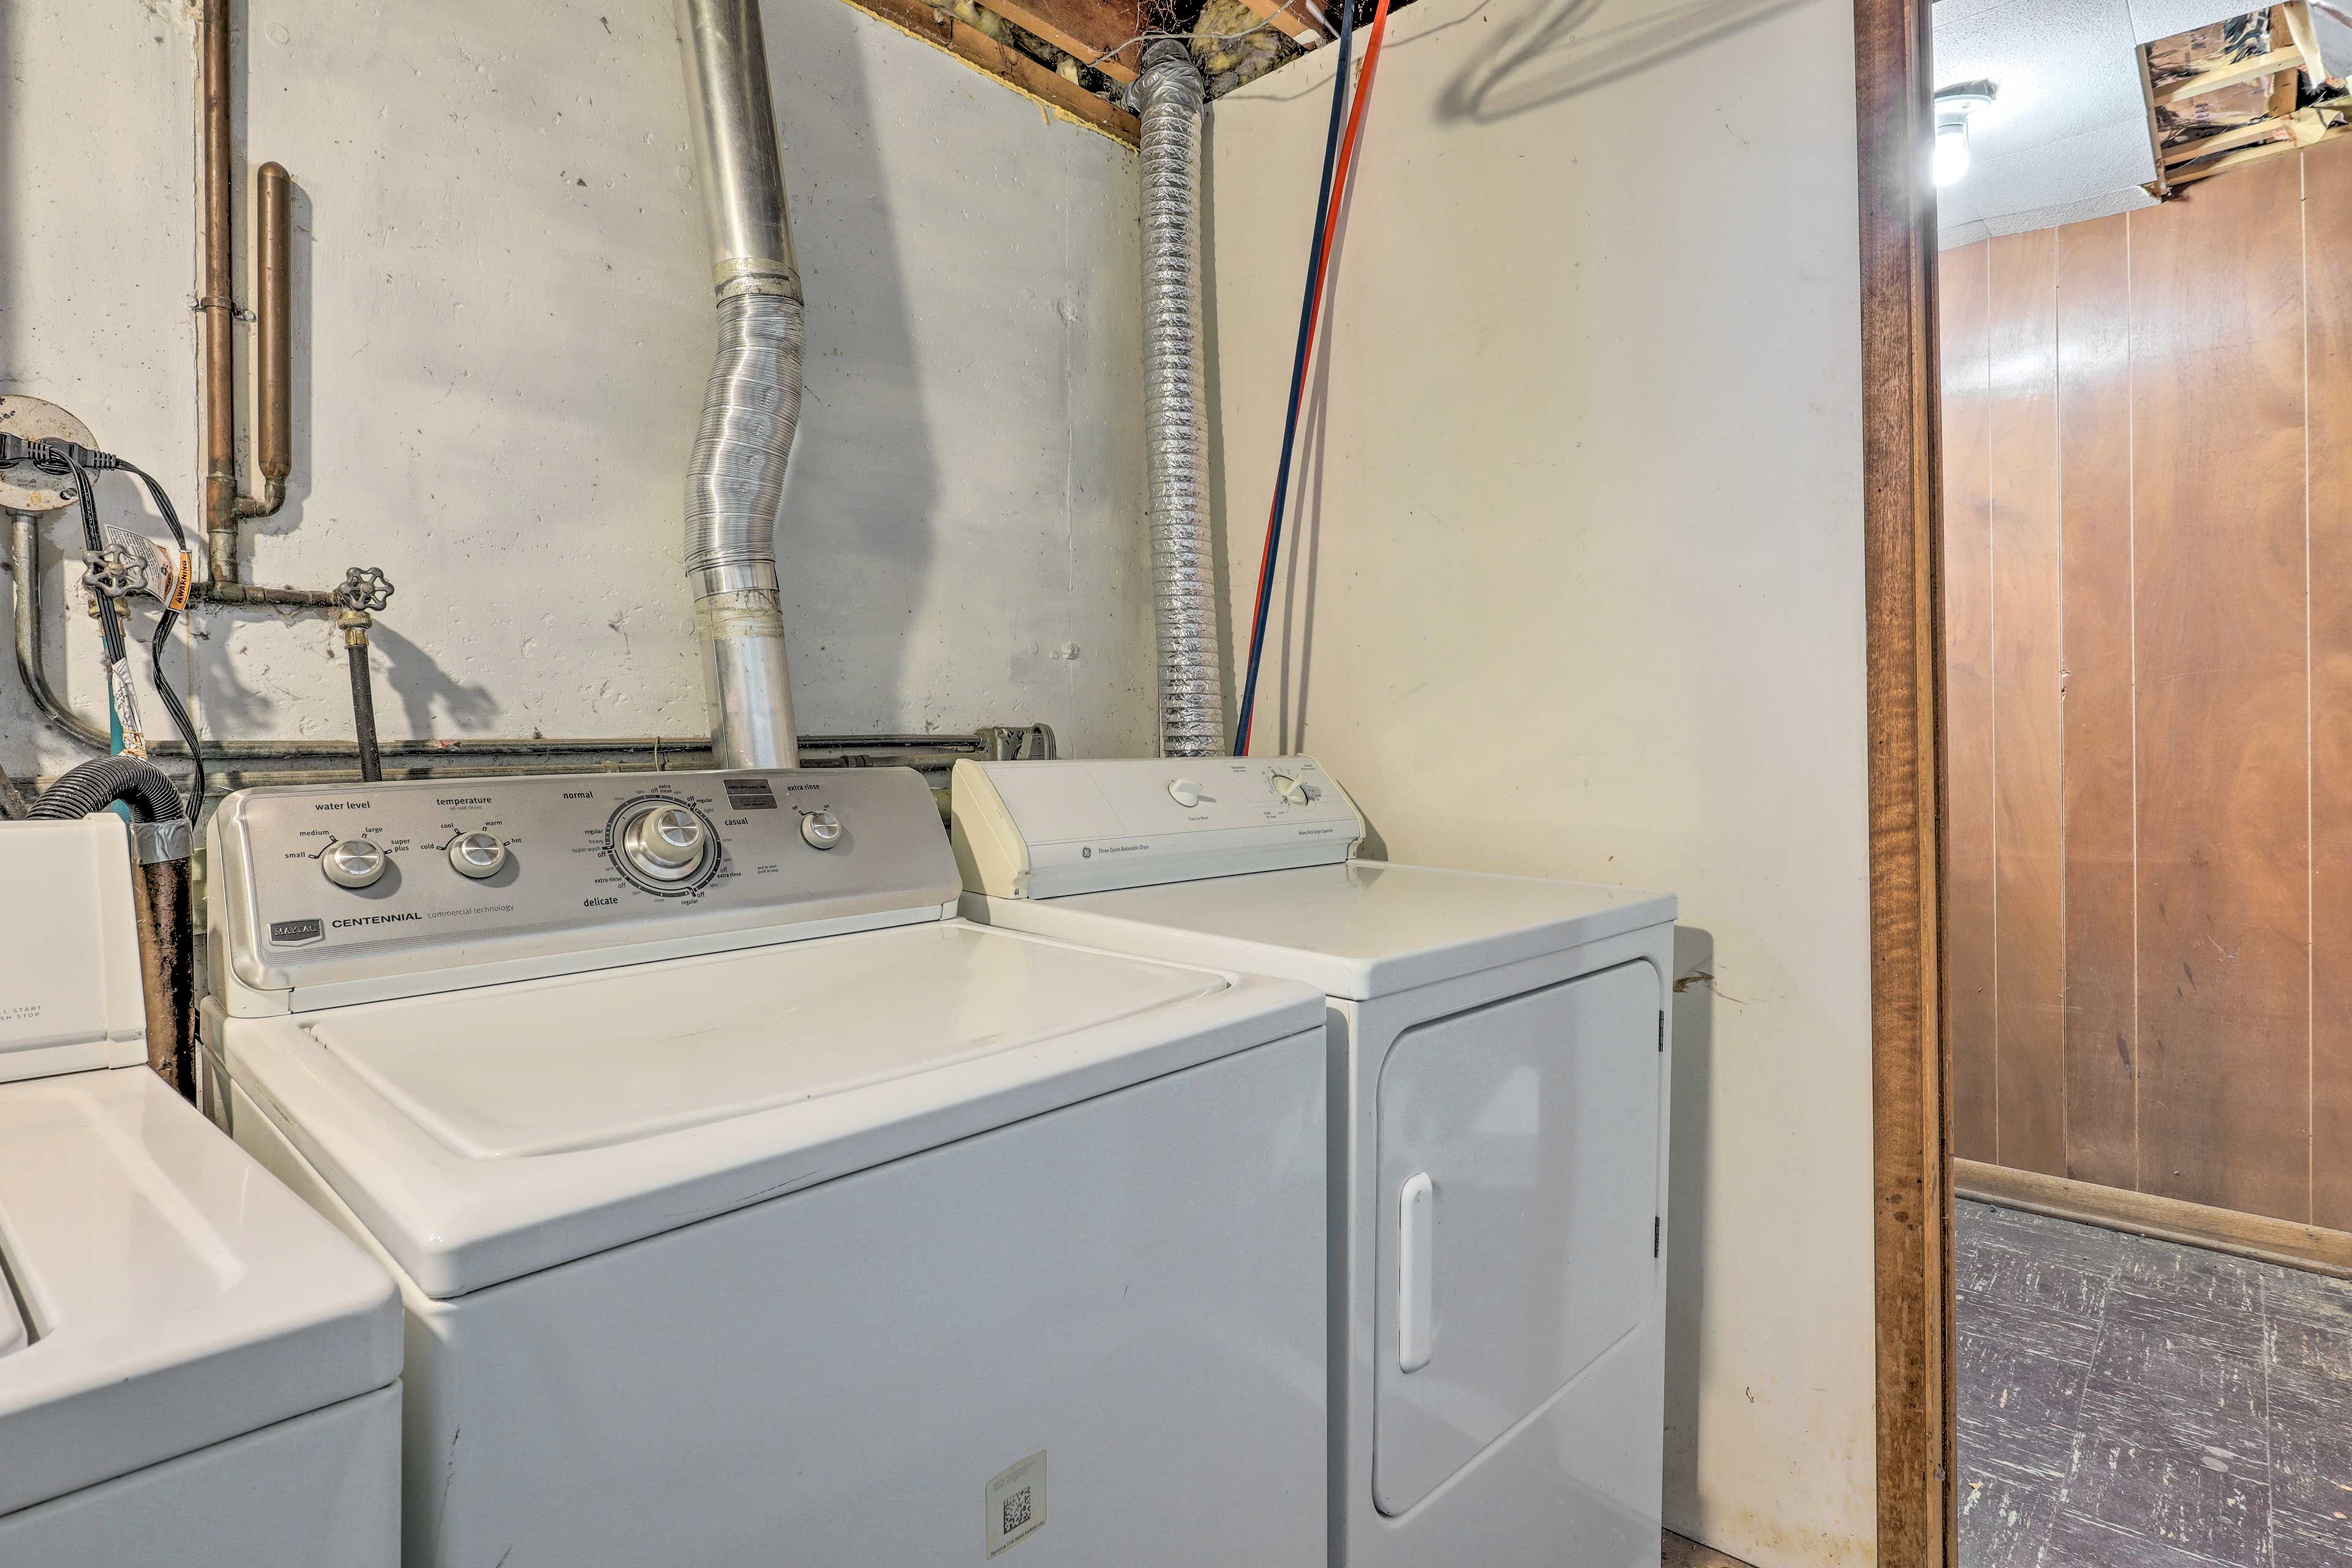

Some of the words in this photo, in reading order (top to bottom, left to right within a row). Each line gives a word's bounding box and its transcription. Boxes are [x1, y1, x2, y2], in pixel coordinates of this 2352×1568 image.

[178, 560, 187, 598] WARNING
[437, 797, 492, 806] temperature
[725, 817, 748, 826] casual
[584, 896, 618, 907] delicate
[274, 924, 317, 936] MAYTAG
[332, 913, 423, 928] CENTENNIAL
[428, 907, 472, 919] commercial
[473, 903, 514, 914] technology
